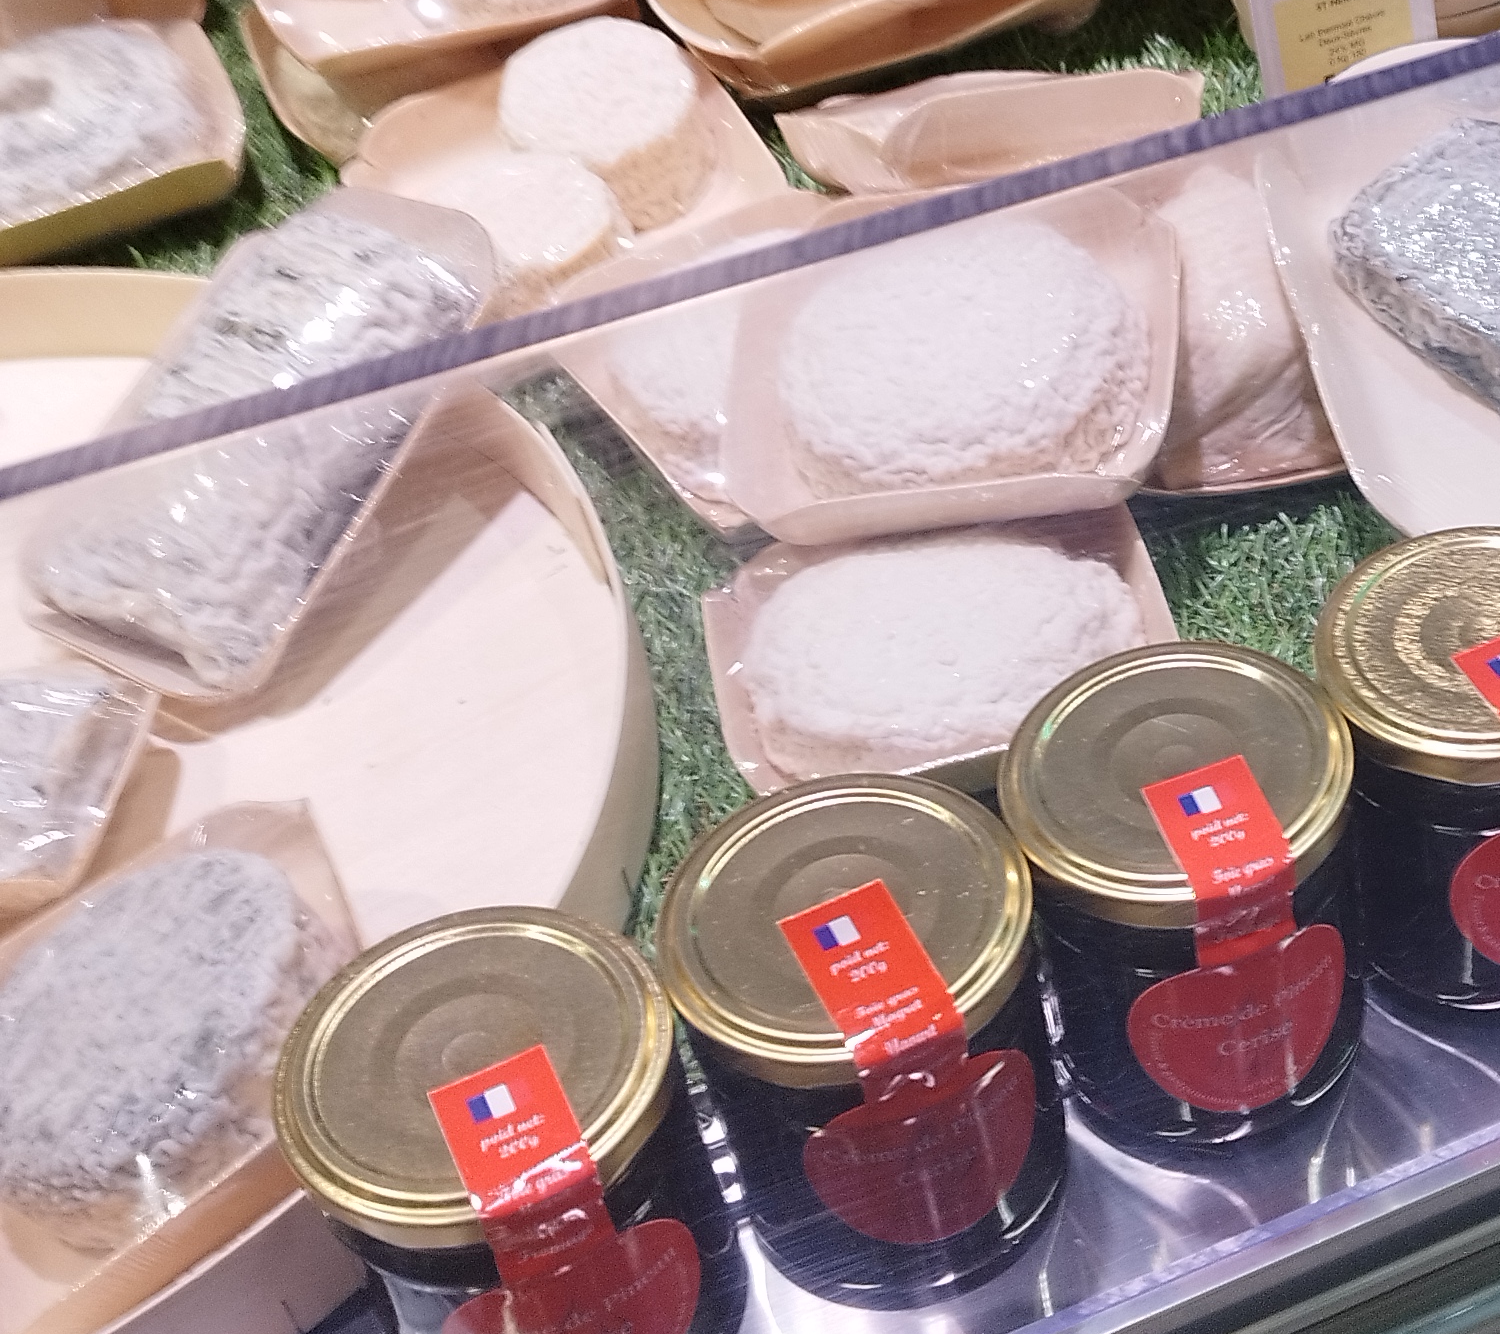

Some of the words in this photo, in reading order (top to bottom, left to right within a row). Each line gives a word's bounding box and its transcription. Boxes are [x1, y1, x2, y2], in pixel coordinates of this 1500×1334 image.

[1150, 1011, 1235, 1031] Crème
[1234, 1001, 1270, 1024] de
[1215, 1019, 1294, 1058] Cerise
[561, 1305, 598, 1331] de
